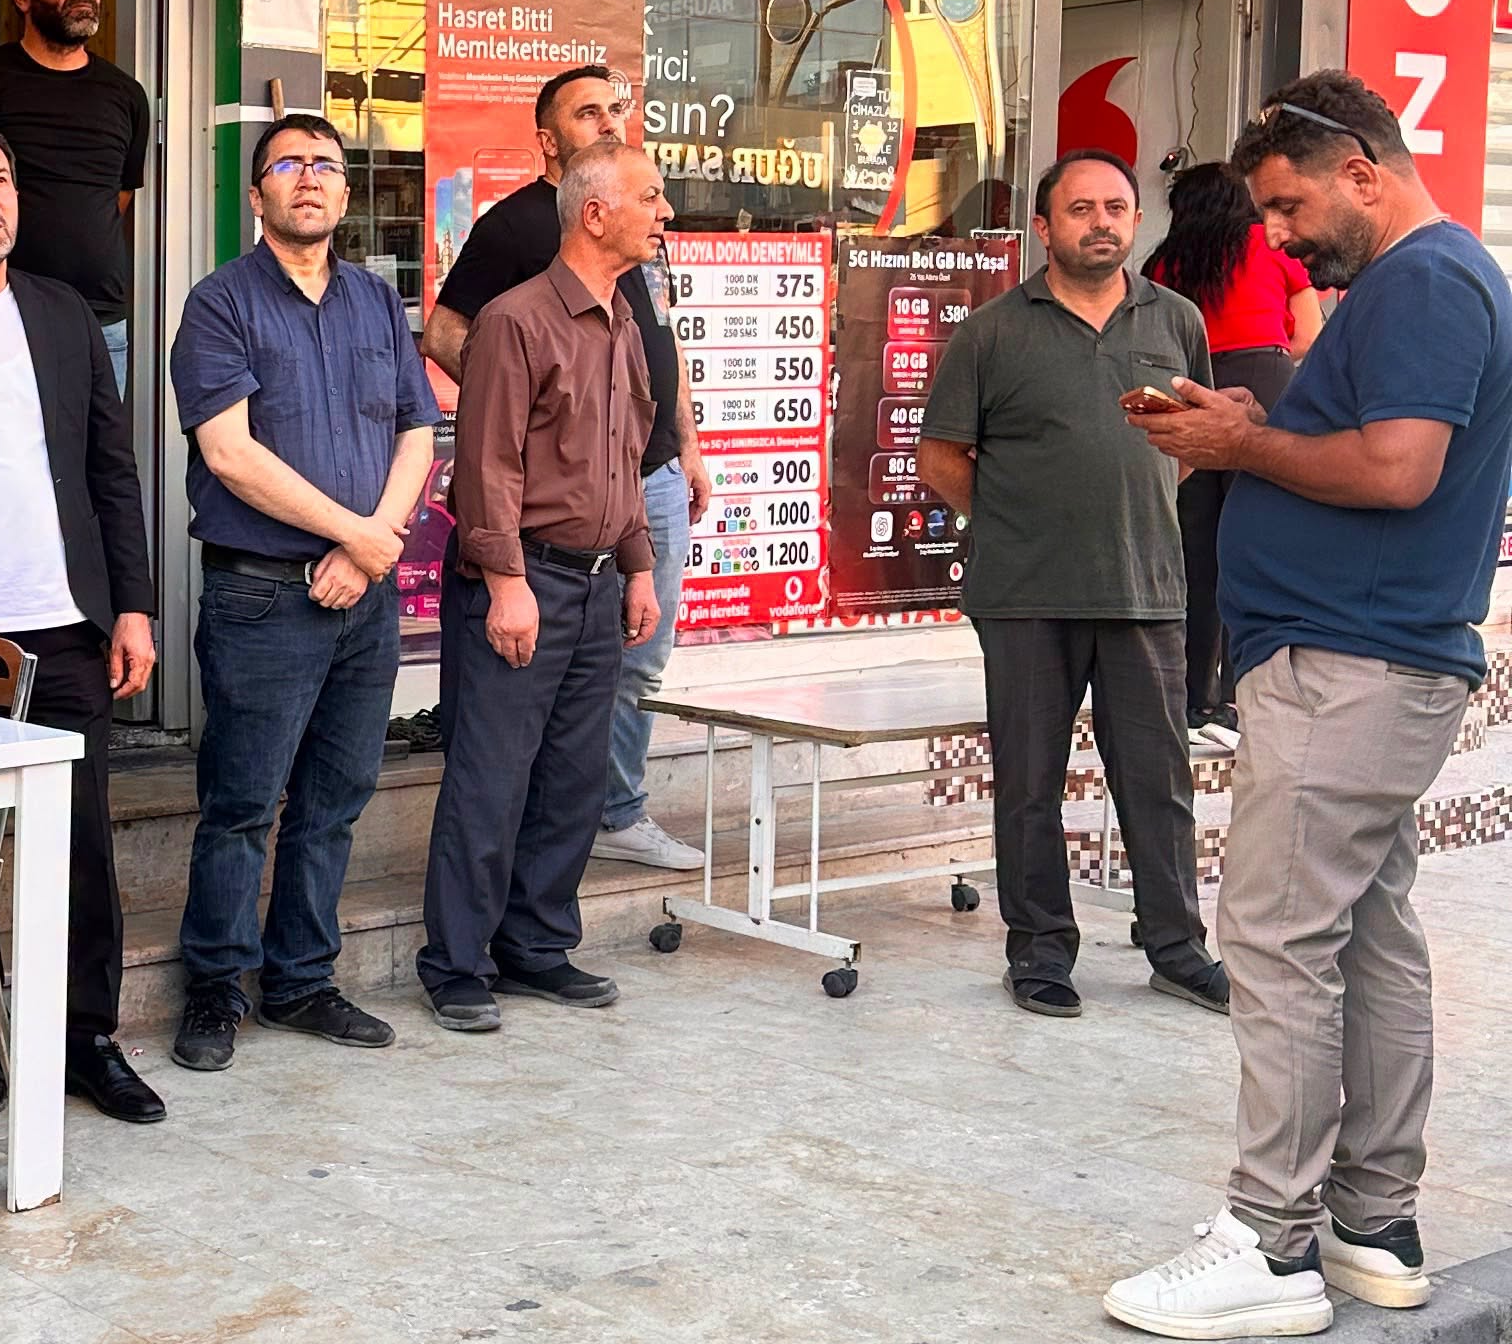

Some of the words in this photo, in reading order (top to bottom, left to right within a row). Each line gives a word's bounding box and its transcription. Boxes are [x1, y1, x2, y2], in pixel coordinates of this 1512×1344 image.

[438, 2, 507, 30] Hasret
[511, 6, 553, 33] Bitti
[438, 32, 607, 64] Memlekettesiniz
[680, 241, 714, 263] DOYA
[716, 240, 749, 263] DOYA
[751, 236, 823, 263] DENEYİMLE
[848, 249, 868, 268] 5G
[870, 250, 910, 269] Hızını
[912, 251, 934, 269] Bol
[935, 252, 955, 270] GB
[956, 253, 974, 270] ile
[974, 253, 1009, 275] Yaşa!
[724, 287, 739, 296] 250
[740, 287, 759, 296] SMS
[776, 274, 814, 297] 375
[894, 298, 910, 315] 10
[911, 299, 930, 315] GB
[676, 316, 706, 341] GB
[775, 315, 814, 339] 450
[723, 328, 738, 338] 250
[739, 328, 758, 337] SMS
[774, 357, 814, 381] 550
[892, 352, 906, 369] 20
[909, 352, 928, 369] GB
[722, 370, 738, 380] 250
[738, 370, 757, 379] SMS
[721, 412, 737, 421] 250
[737, 411, 756, 420] SMS
[773, 398, 812, 422] 650
[890, 408, 907, 424] 40
[772, 460, 811, 484] 900
[888, 457, 904, 474] 80
[906, 458, 916, 474] G
[767, 501, 810, 526] 1.000
[766, 541, 809, 566] 1.200
[690, 606, 709, 624] gün
[710, 602, 750, 619] ücretsiz
